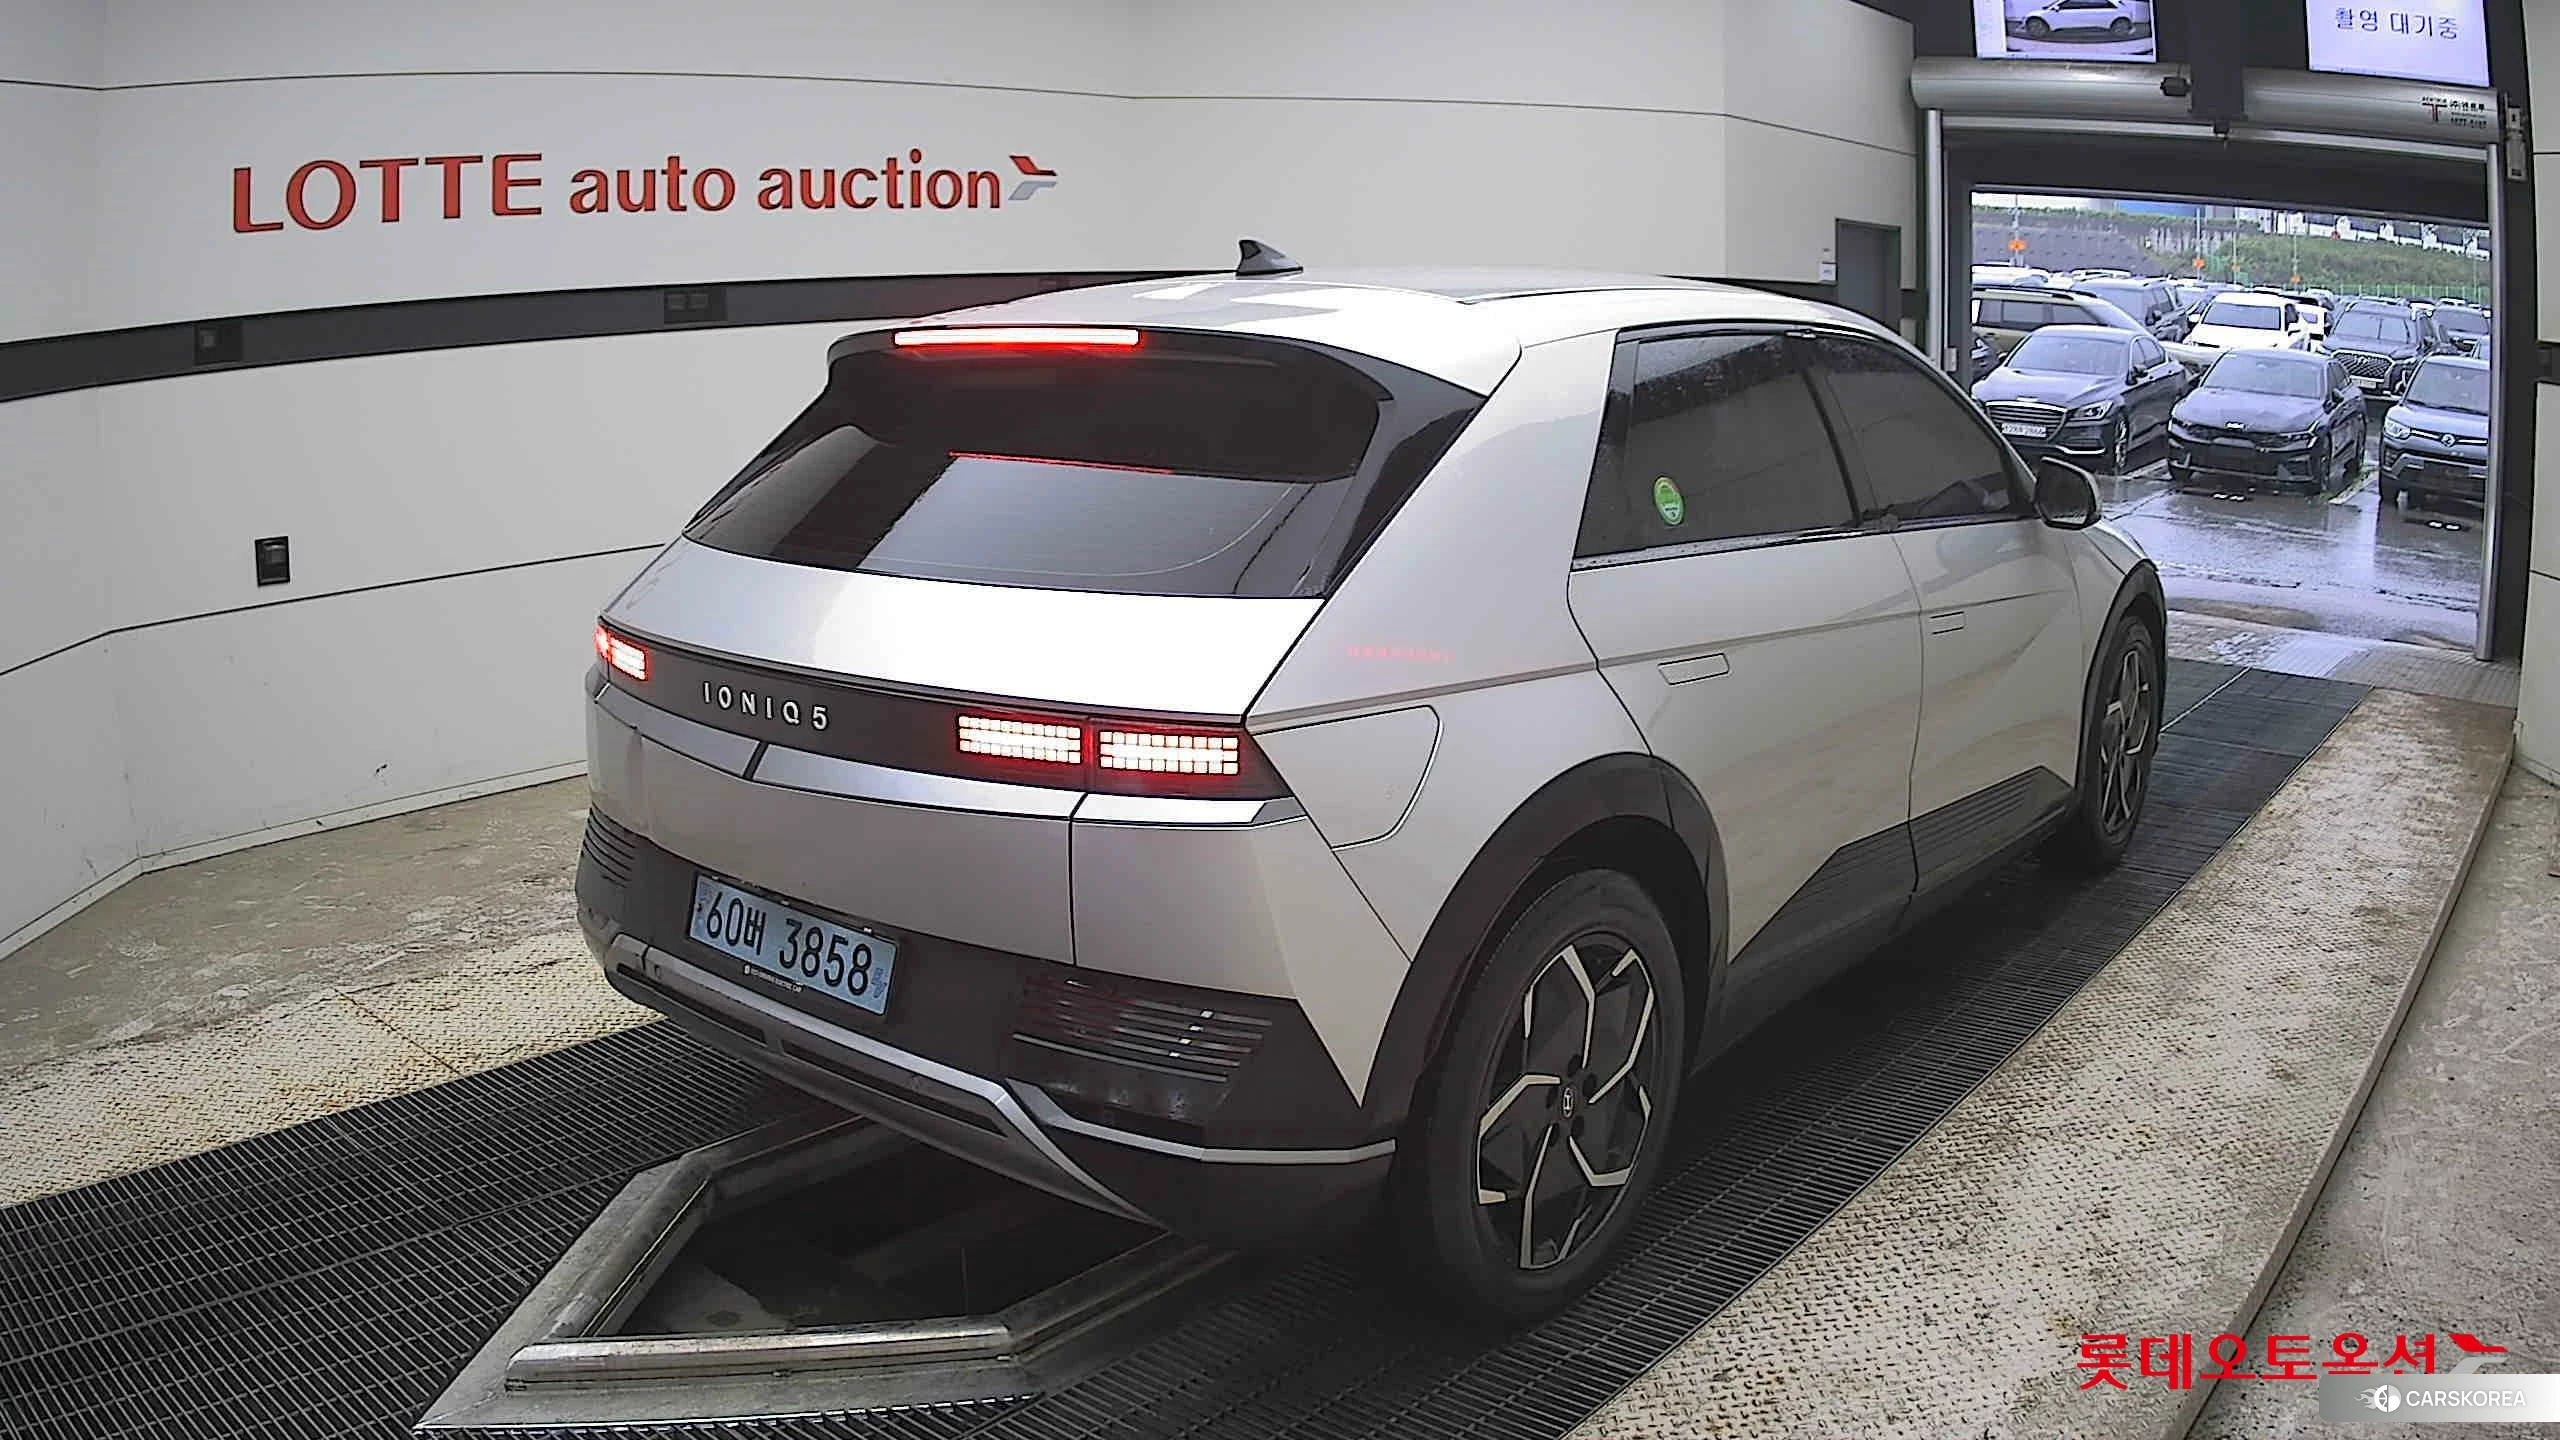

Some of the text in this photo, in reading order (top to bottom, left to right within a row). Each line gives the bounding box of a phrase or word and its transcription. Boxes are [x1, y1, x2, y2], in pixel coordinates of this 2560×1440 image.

[2390, 12, 2457, 40] 대기중
[232, 148, 1002, 234] LOTTE auto auction
[703, 681, 829, 731] IONIQ 5
[706, 891, 767, 956] 60버
[778, 917, 872, 996] 3858
